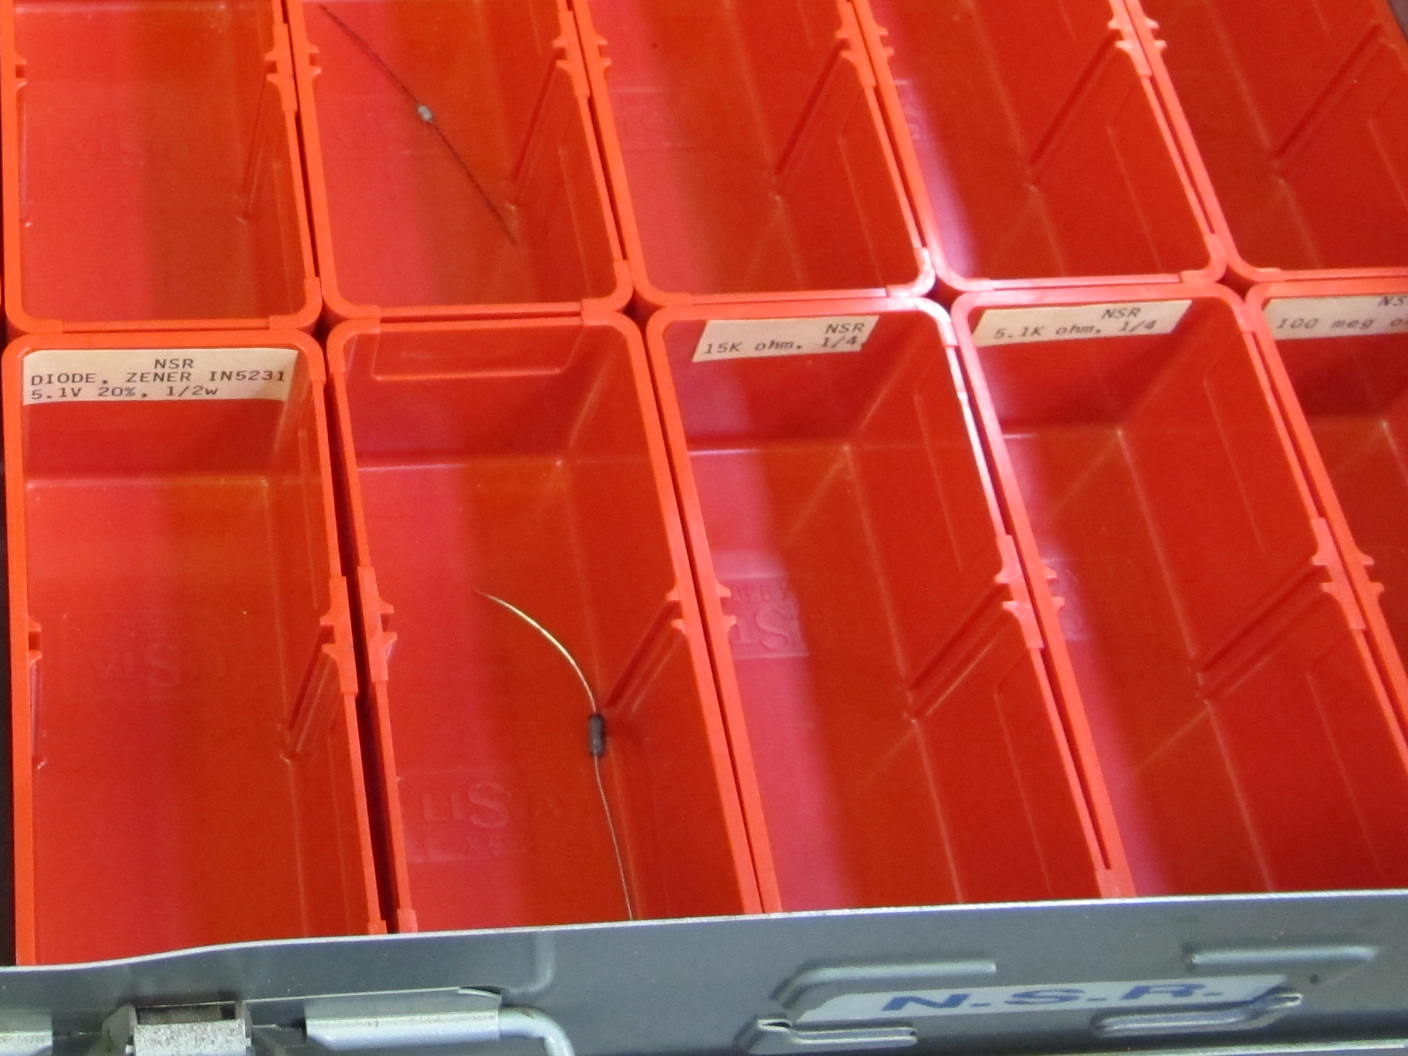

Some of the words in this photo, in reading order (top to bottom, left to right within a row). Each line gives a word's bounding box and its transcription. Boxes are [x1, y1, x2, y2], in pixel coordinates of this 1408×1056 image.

[1101, 306, 1142, 320] NSR
[824, 322, 866, 335] NSR
[993, 326, 1045, 340] 5.1K
[1120, 319, 1157, 334] 1/4
[1276, 317, 1320, 329] 100
[1329, 317, 1377, 330] meg
[704, 343, 743, 355] 15K
[154, 358, 195, 370] NSR
[126, 371, 192, 383] ZENER
[31, 387, 83, 400] 5.1V
[167, 385, 219, 398] 1/2w
[880, 982, 1226, 1013] N.S.R.
